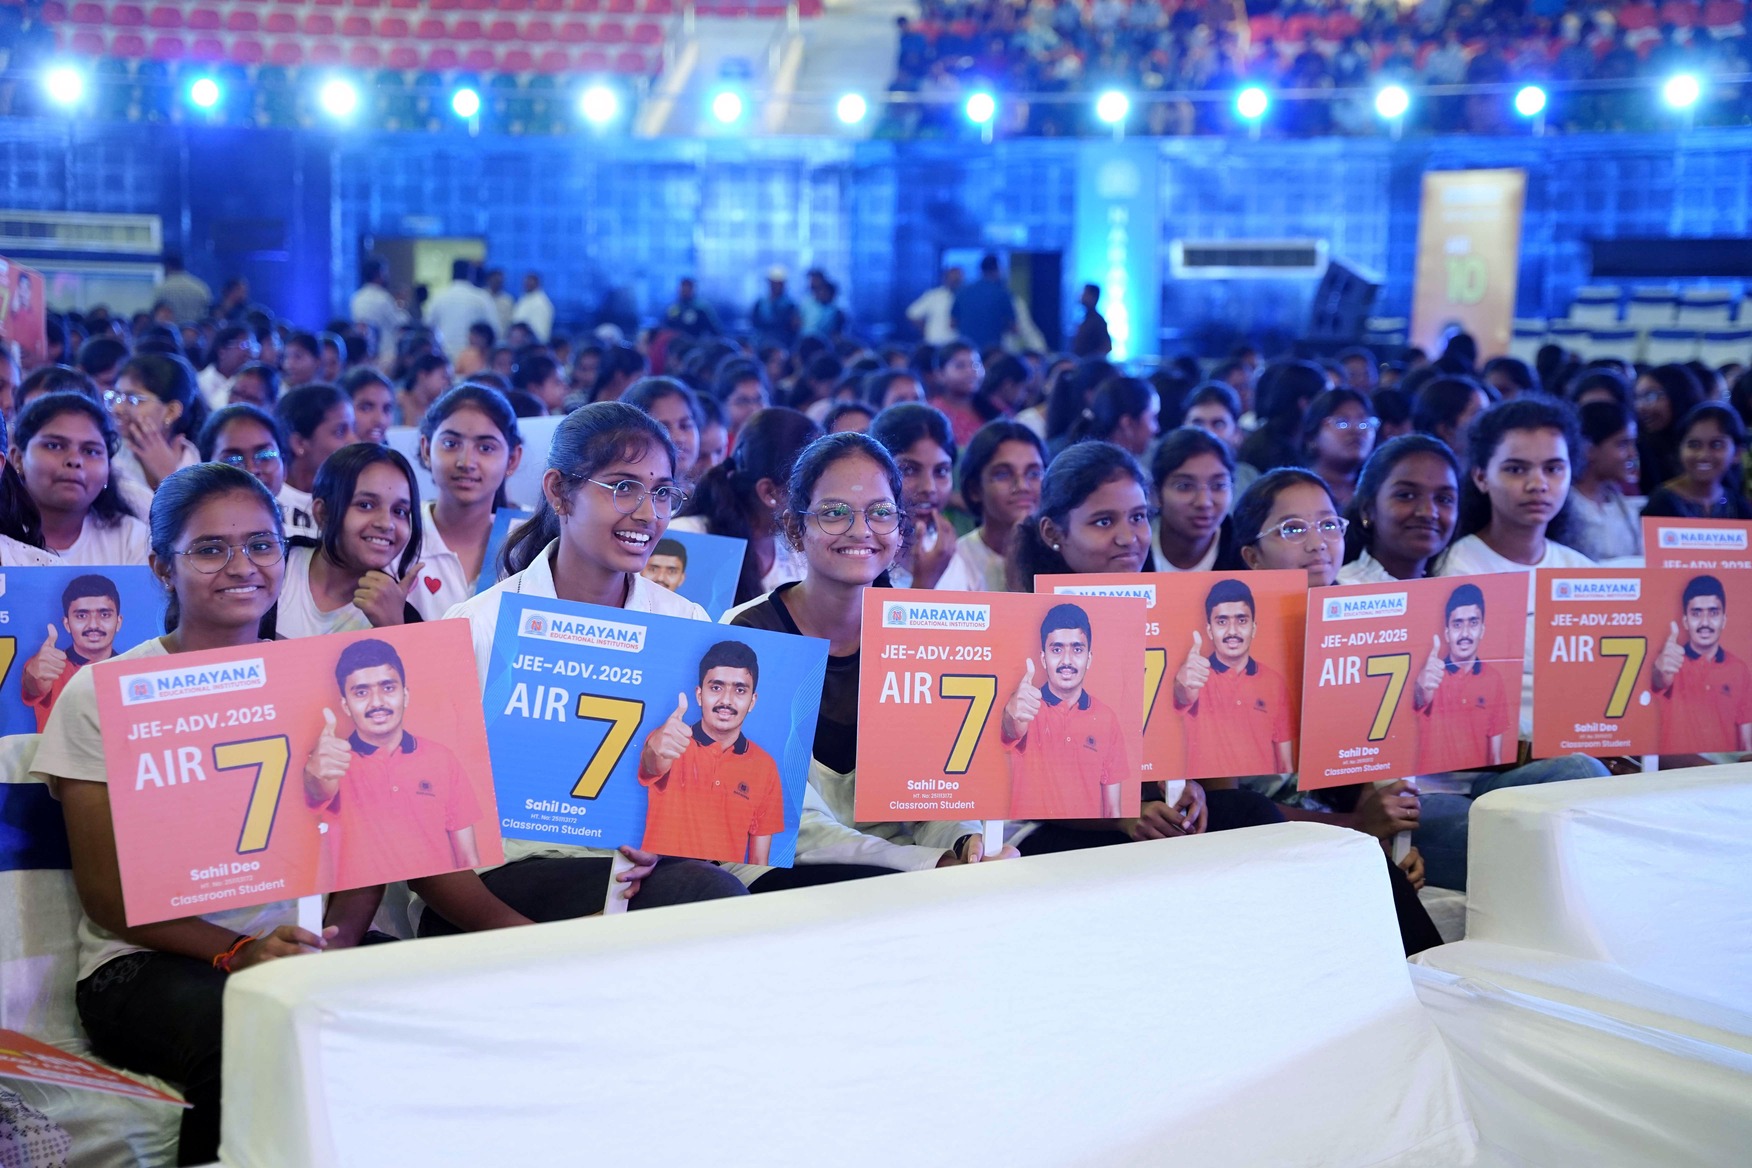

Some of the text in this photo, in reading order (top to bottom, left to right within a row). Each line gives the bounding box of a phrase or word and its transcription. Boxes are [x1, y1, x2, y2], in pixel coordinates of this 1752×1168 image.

[1574, 584, 1636, 593] NARAYANA
[910, 608, 986, 622] NARAYANA
[1344, 598, 1403, 612] NARAYANA
[1550, 613, 1643, 626] JEE-ADV.2025
[550, 632, 639, 650] EDUCATIONAL INSTITUTIONS
[551, 620, 639, 643] NARAYANA
[1320, 628, 1408, 648] JEE-ADV.2025
[881, 644, 992, 661] JEE-ADV.2025
[157, 666, 260, 691] NARAYANA
[512, 654, 643, 685] JEE-ADV.2025
[1550, 635, 1648, 719] AIR 7
[159, 678, 261, 698] EDUCATIONAL INSTITUTIONS
[1318, 652, 1412, 742] AIR 7
[127, 704, 277, 740] JEE-ADV.2025
[879, 671, 998, 775] AIR 7
[1574, 722, 1618, 732] Sahil Deo
[504, 682, 646, 801] AIR 7
[1338, 746, 1380, 758] Sahil Deo
[1324, 762, 1391, 776] Classroom Student
[907, 778, 959, 790] Sahil Deo
[134, 734, 291, 856] AIR 7
[889, 800, 975, 810] Classroom Student
[525, 798, 587, 816] Sahil Deo
[502, 818, 602, 838] Classroom Student
[190, 860, 260, 881] Sahil Deo
[170, 878, 285, 907] Classroom Student
